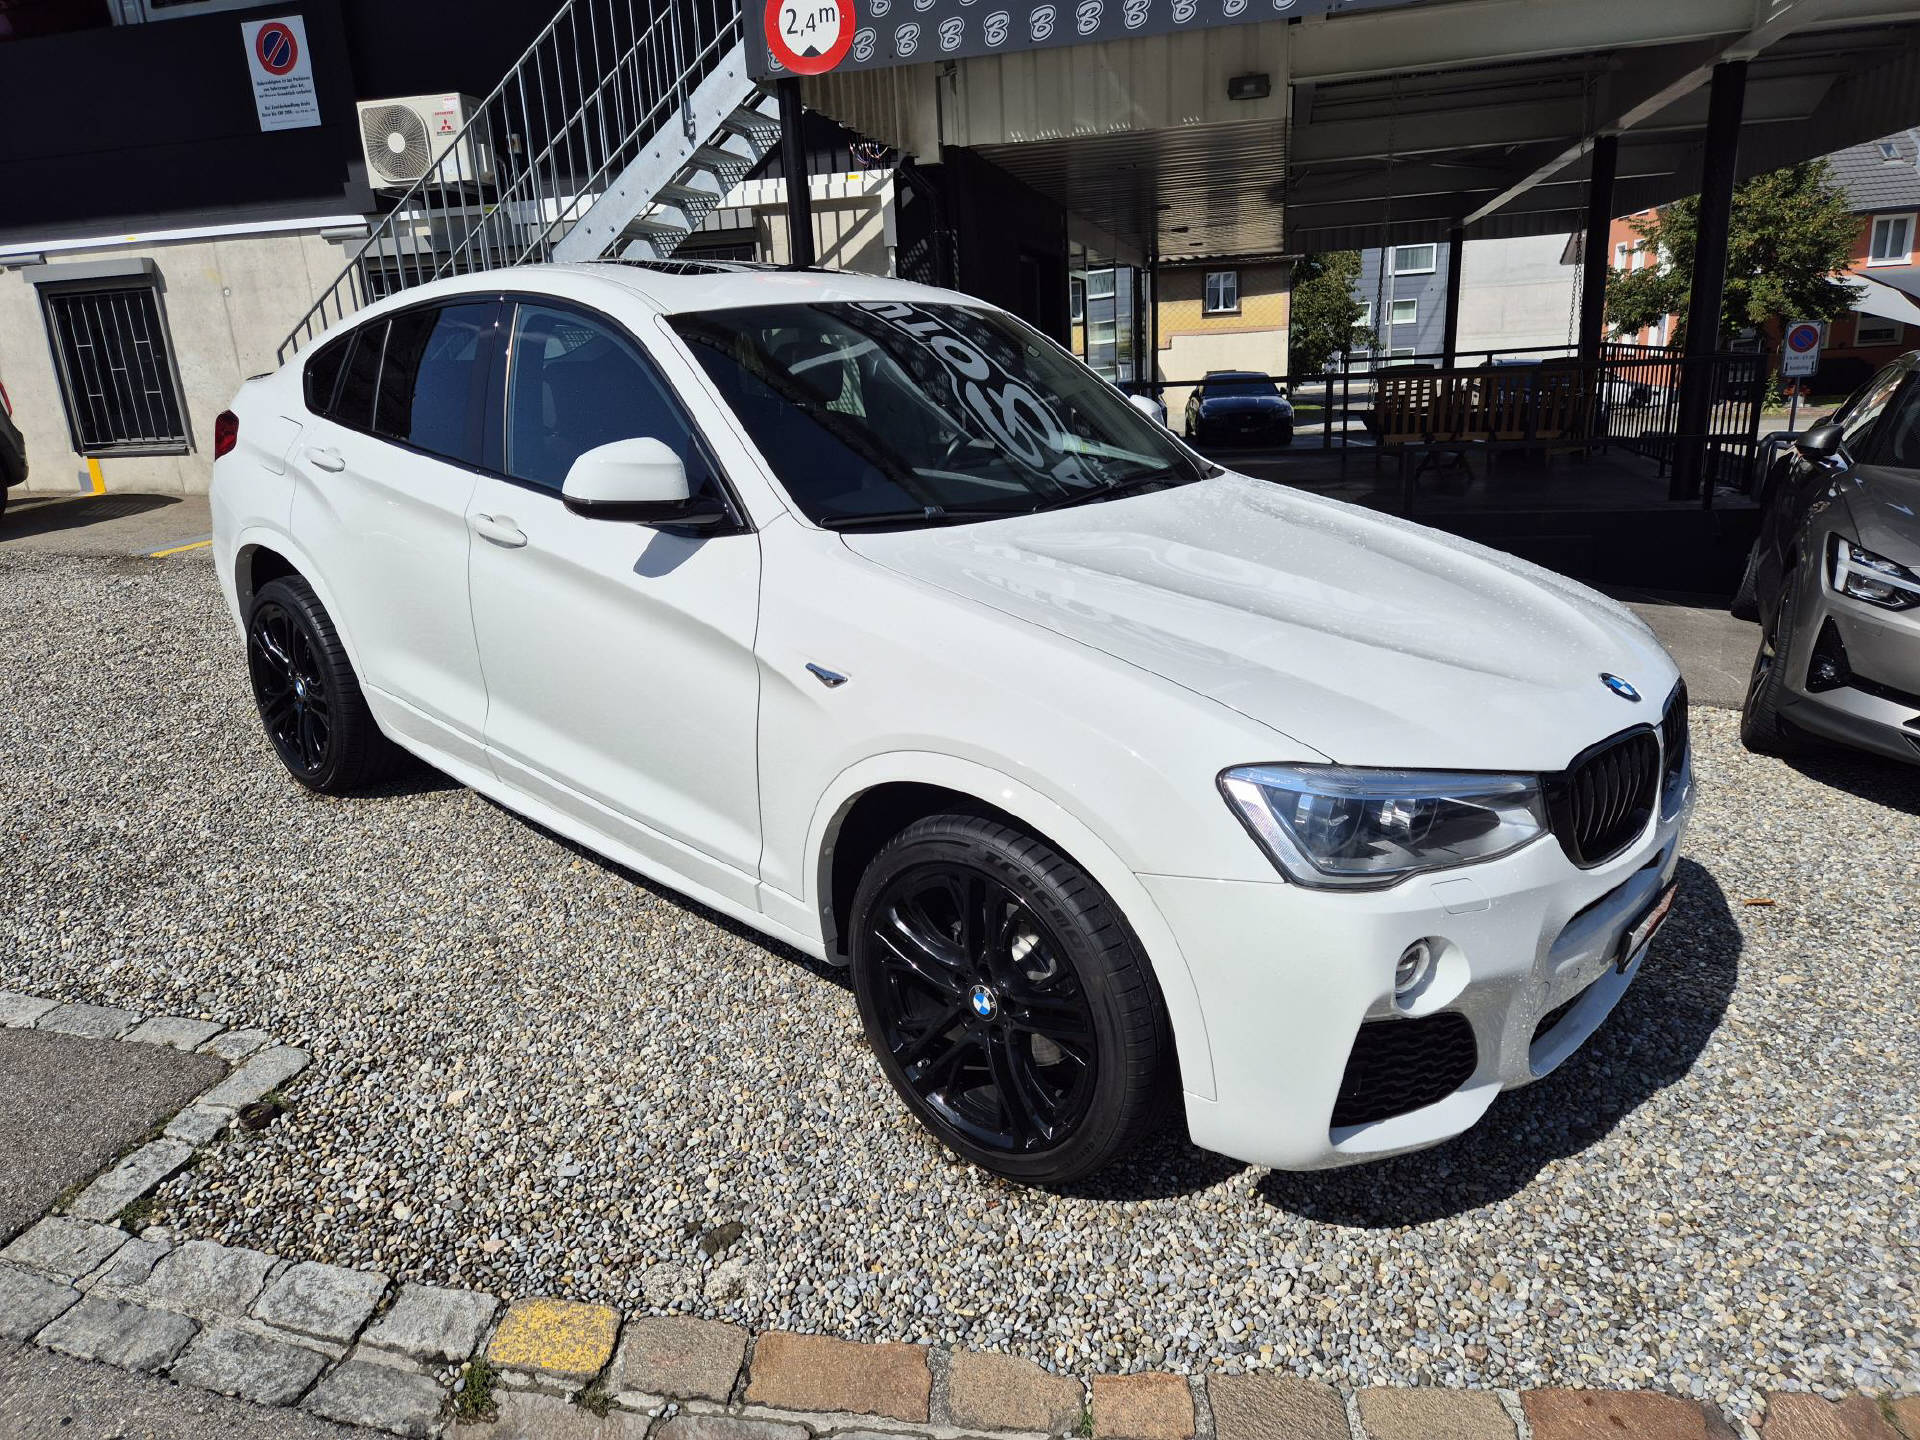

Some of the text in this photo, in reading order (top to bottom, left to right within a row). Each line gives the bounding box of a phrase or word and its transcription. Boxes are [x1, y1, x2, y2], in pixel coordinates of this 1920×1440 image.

[853, 28, 876, 62] B
[895, 22, 920, 57] B
[939, 17, 964, 51] B
[984, 11, 1009, 47] B
[1030, 5, 1056, 41] B
[1076, 0, 1103, 36] B
[1123, 0, 1150, 30] B
